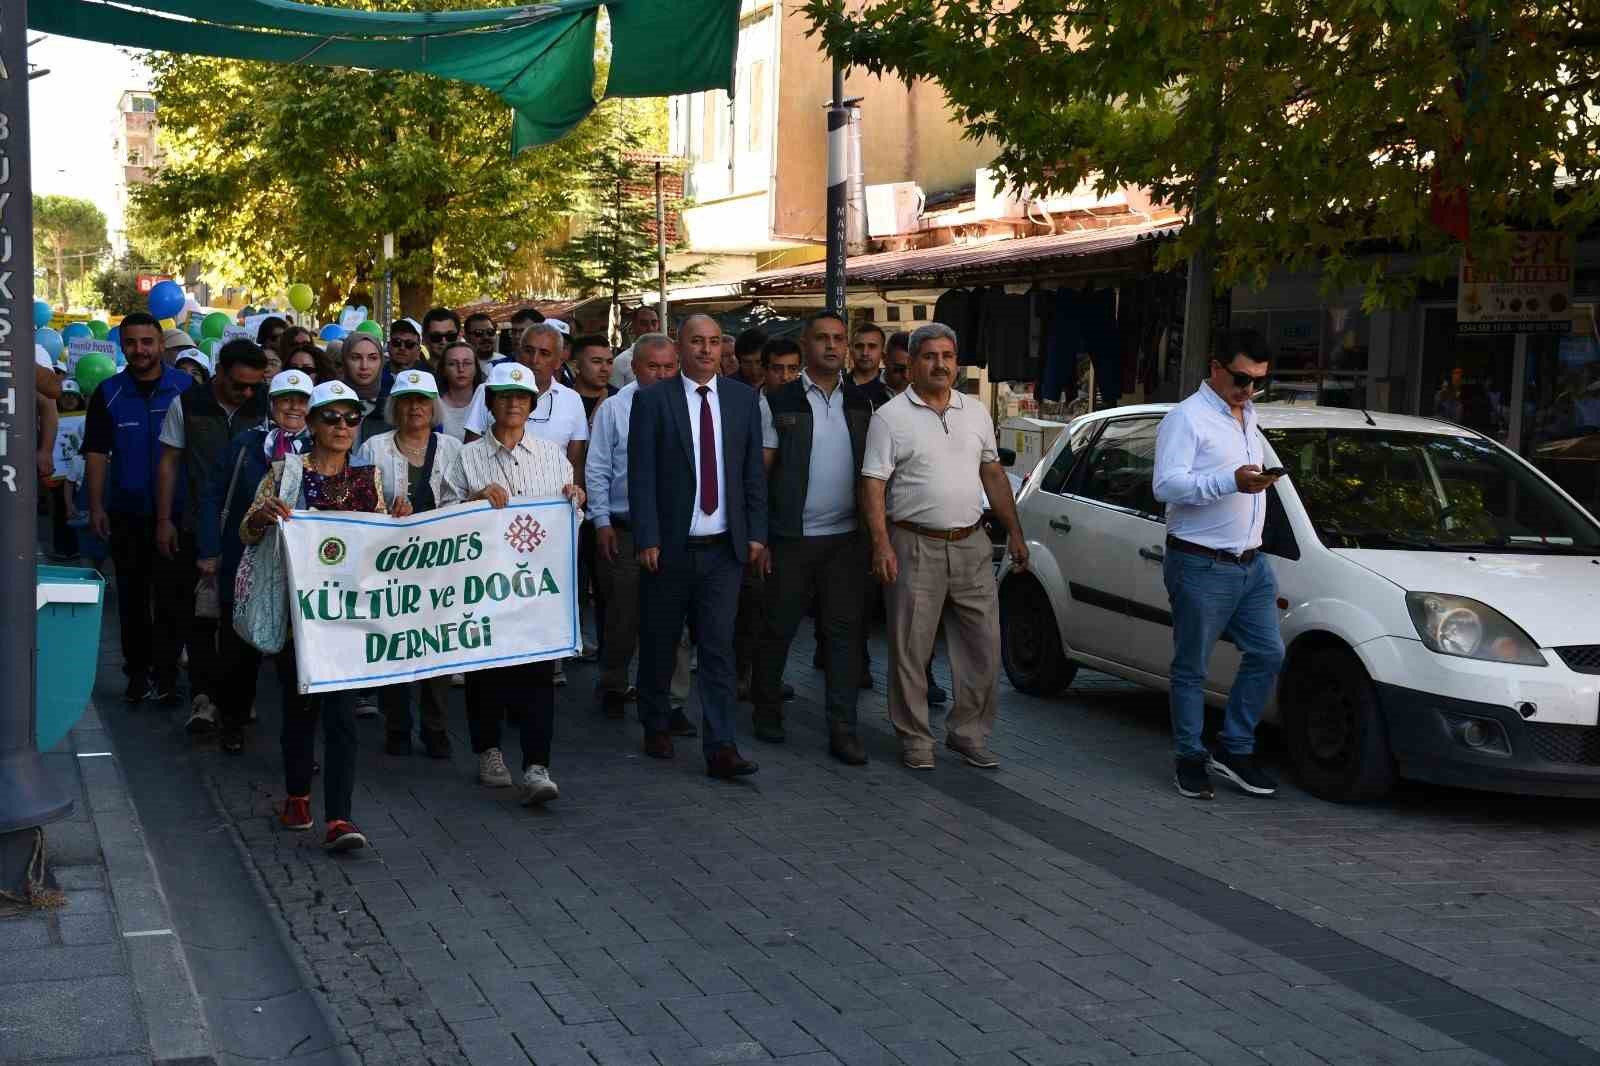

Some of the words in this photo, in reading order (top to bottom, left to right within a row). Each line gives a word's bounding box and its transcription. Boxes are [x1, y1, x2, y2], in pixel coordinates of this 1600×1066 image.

[375, 531, 483, 572] GÖRDES
[297, 578, 422, 621] KÜLTÜR
[430, 585, 456, 611] ve
[463, 561, 560, 605] DOĞA
